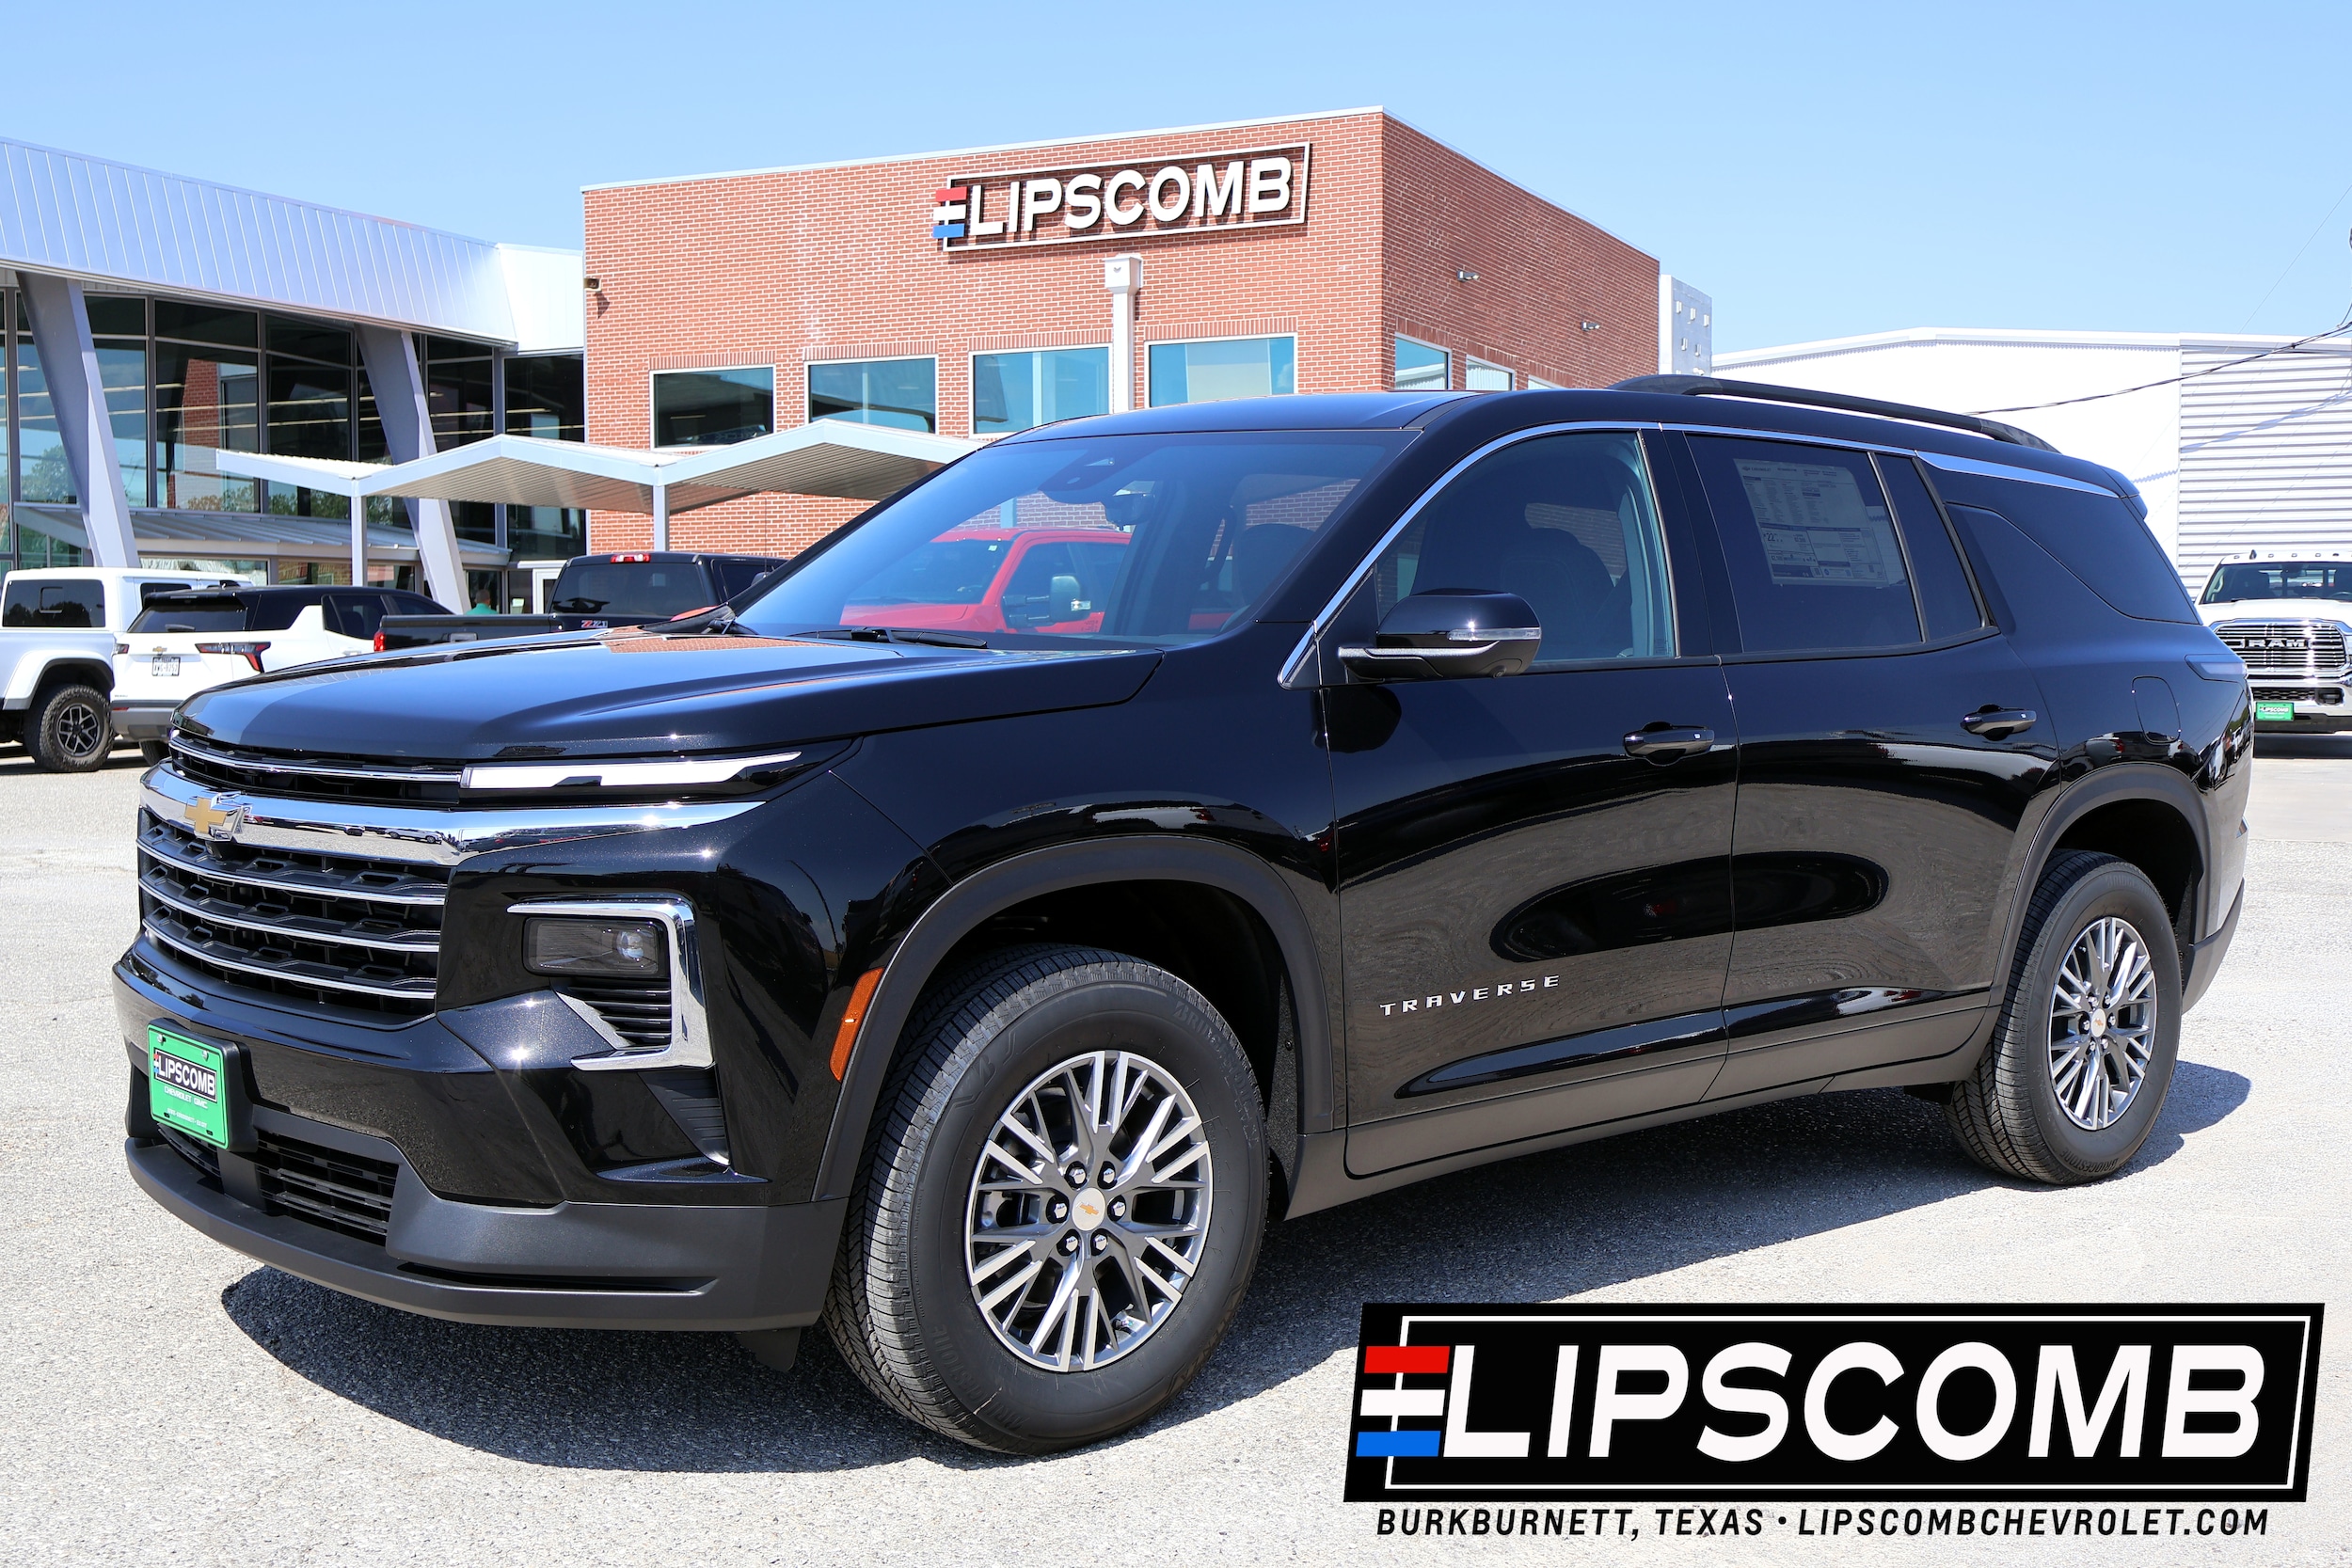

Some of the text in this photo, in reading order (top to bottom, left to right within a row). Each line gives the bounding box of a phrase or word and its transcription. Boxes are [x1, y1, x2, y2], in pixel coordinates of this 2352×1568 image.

[969, 156, 1294, 237] LIPSCOMB
[581, 620, 609, 628] Z71
[2249, 638, 2306, 648] RAM
[1379, 974, 1560, 1017] TRAVERSE
[158, 1054, 215, 1096] LIPSCOMB
[164, 1085, 192, 1103] CHEVROLET
